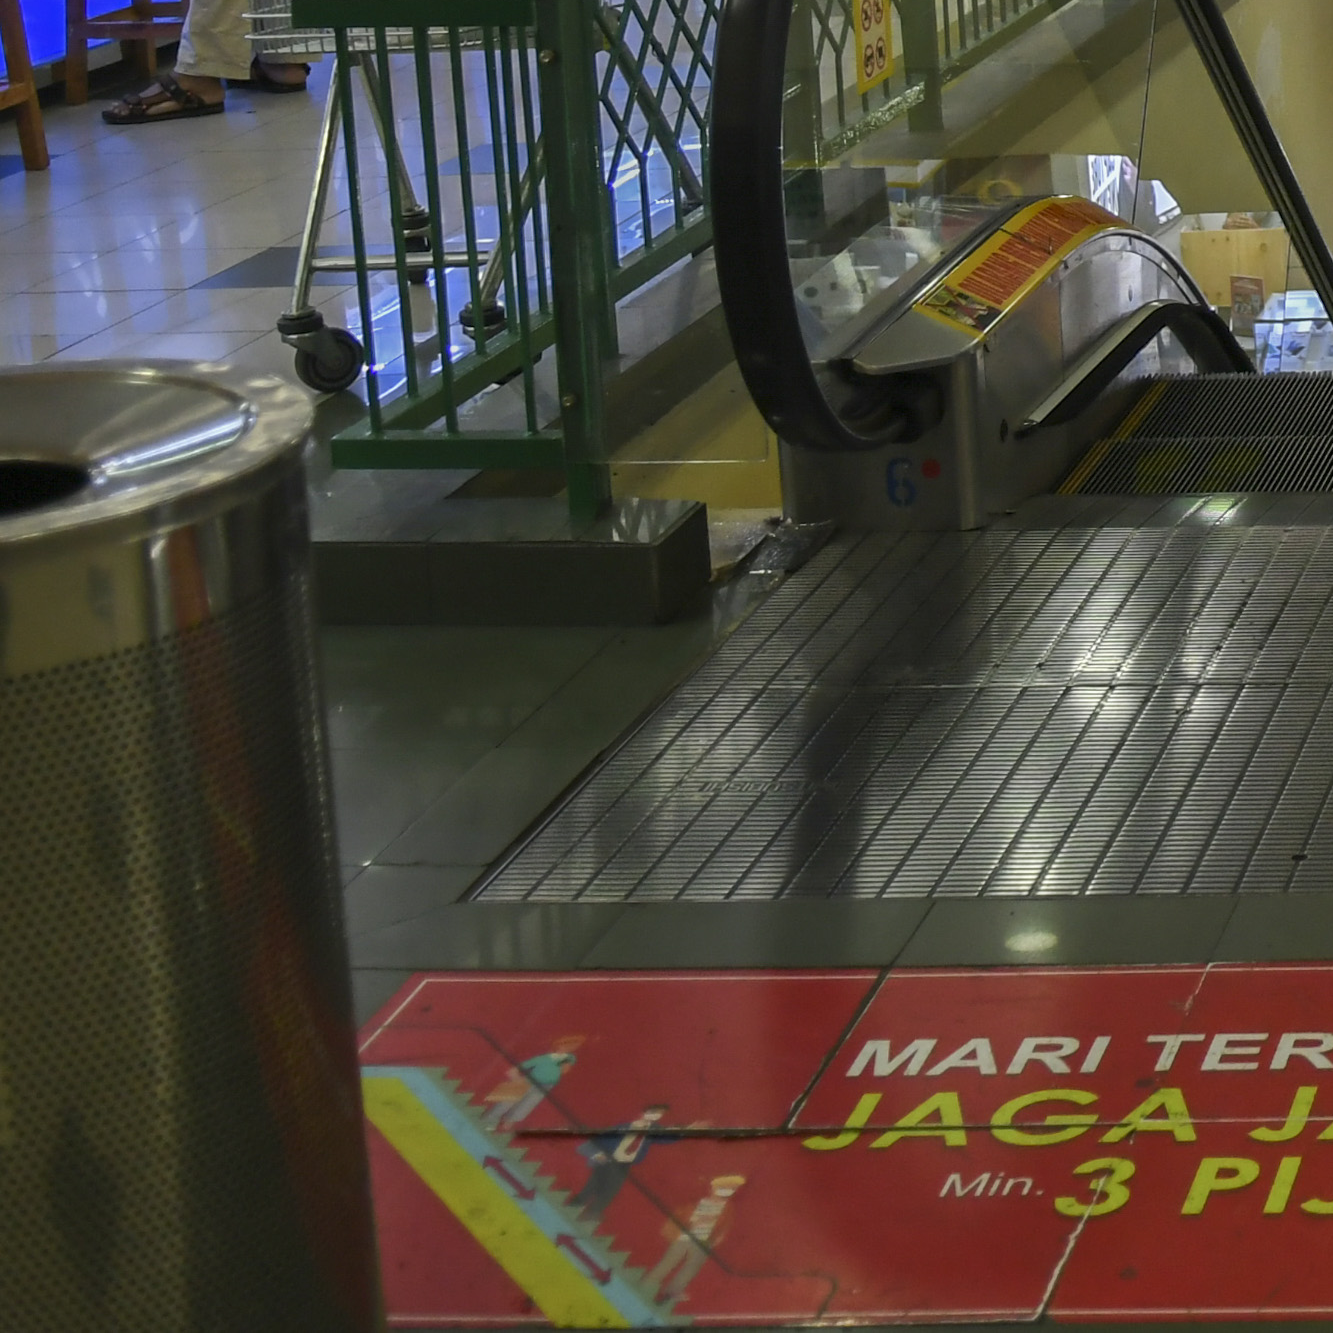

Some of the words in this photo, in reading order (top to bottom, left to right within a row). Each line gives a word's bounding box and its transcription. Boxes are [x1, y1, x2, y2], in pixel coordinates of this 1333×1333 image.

[887, 457, 916, 507] 6
[845, 1035, 1112, 1077] MARI
[802, 1087, 1198, 1151] JAGA
[940, 1172, 1045, 1198] Min.
[1054, 1156, 1136, 1220] 3
